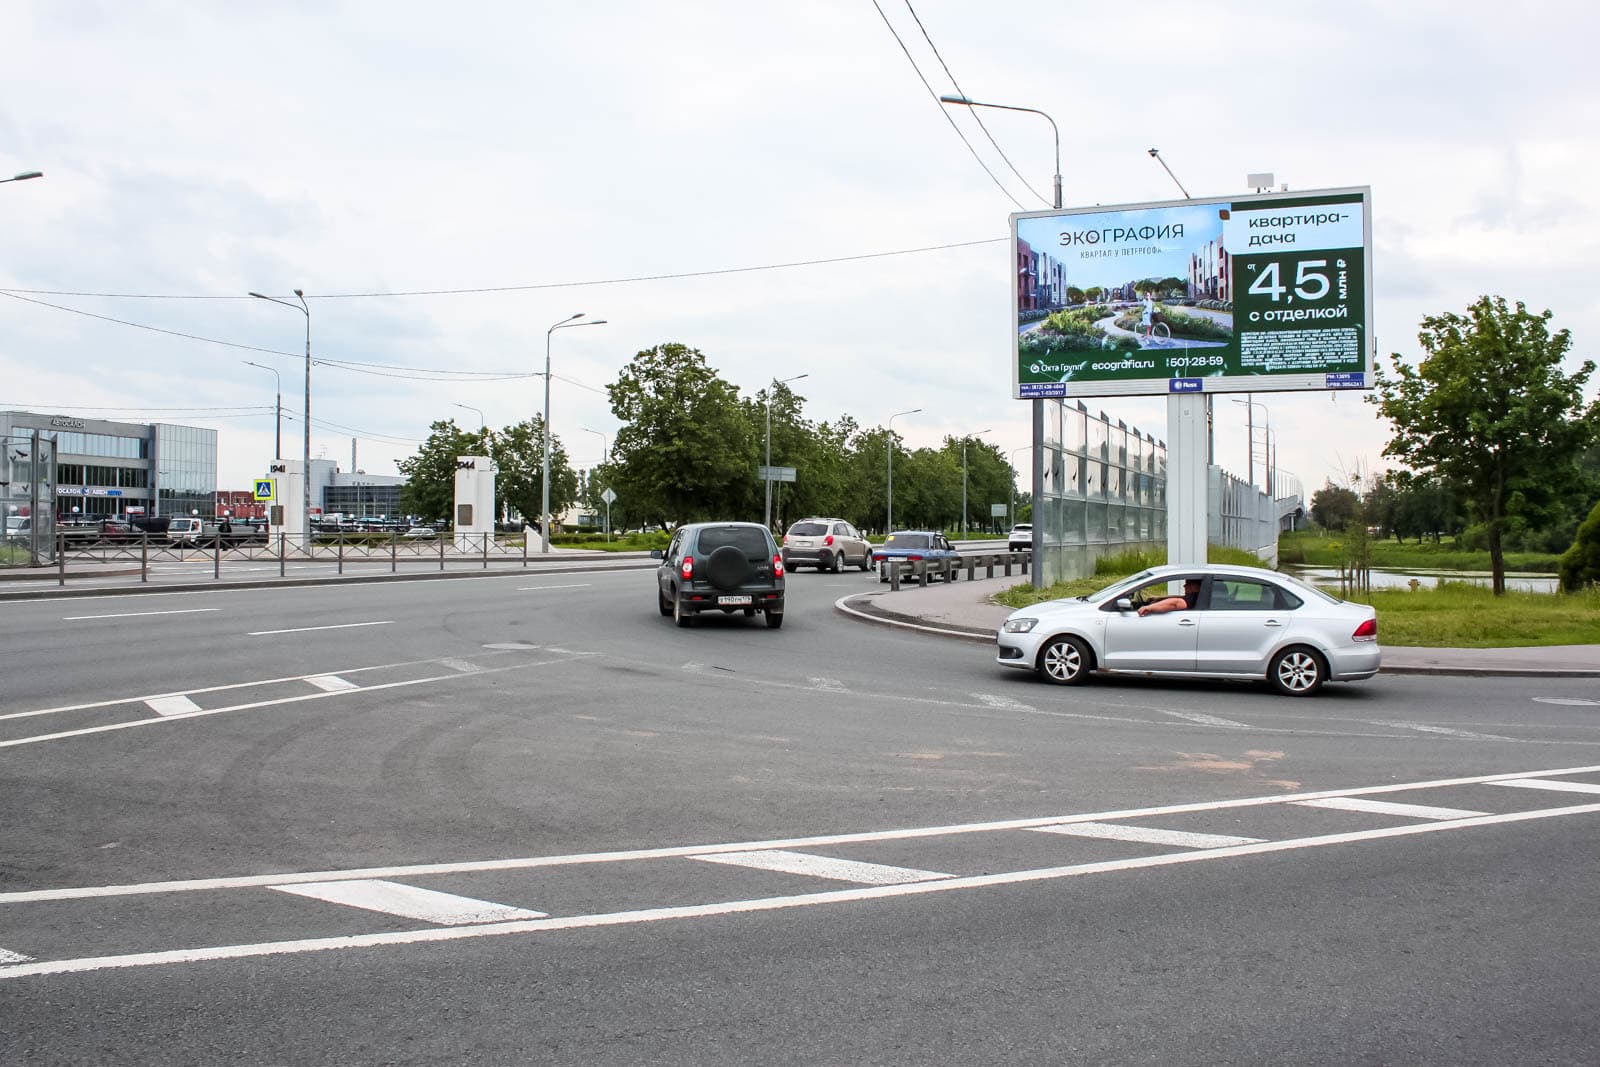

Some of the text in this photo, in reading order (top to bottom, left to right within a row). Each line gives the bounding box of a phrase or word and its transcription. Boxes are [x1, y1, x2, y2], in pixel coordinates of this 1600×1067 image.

[1249, 212, 1350, 229] квартира-
[1059, 223, 1184, 247] ЭКОГРАФИЯ
[1248, 233, 1296, 247] дача
[1080, 249, 1112, 259] КВАРТАЛ
[1248, 259, 1330, 304] 4,5
[1338, 271, 1347, 299] млн
[1249, 304, 1348, 322] с отделкой
[1041, 363, 1082, 373] Охта Групп
[1091, 359, 1155, 371] ecografia.ru
